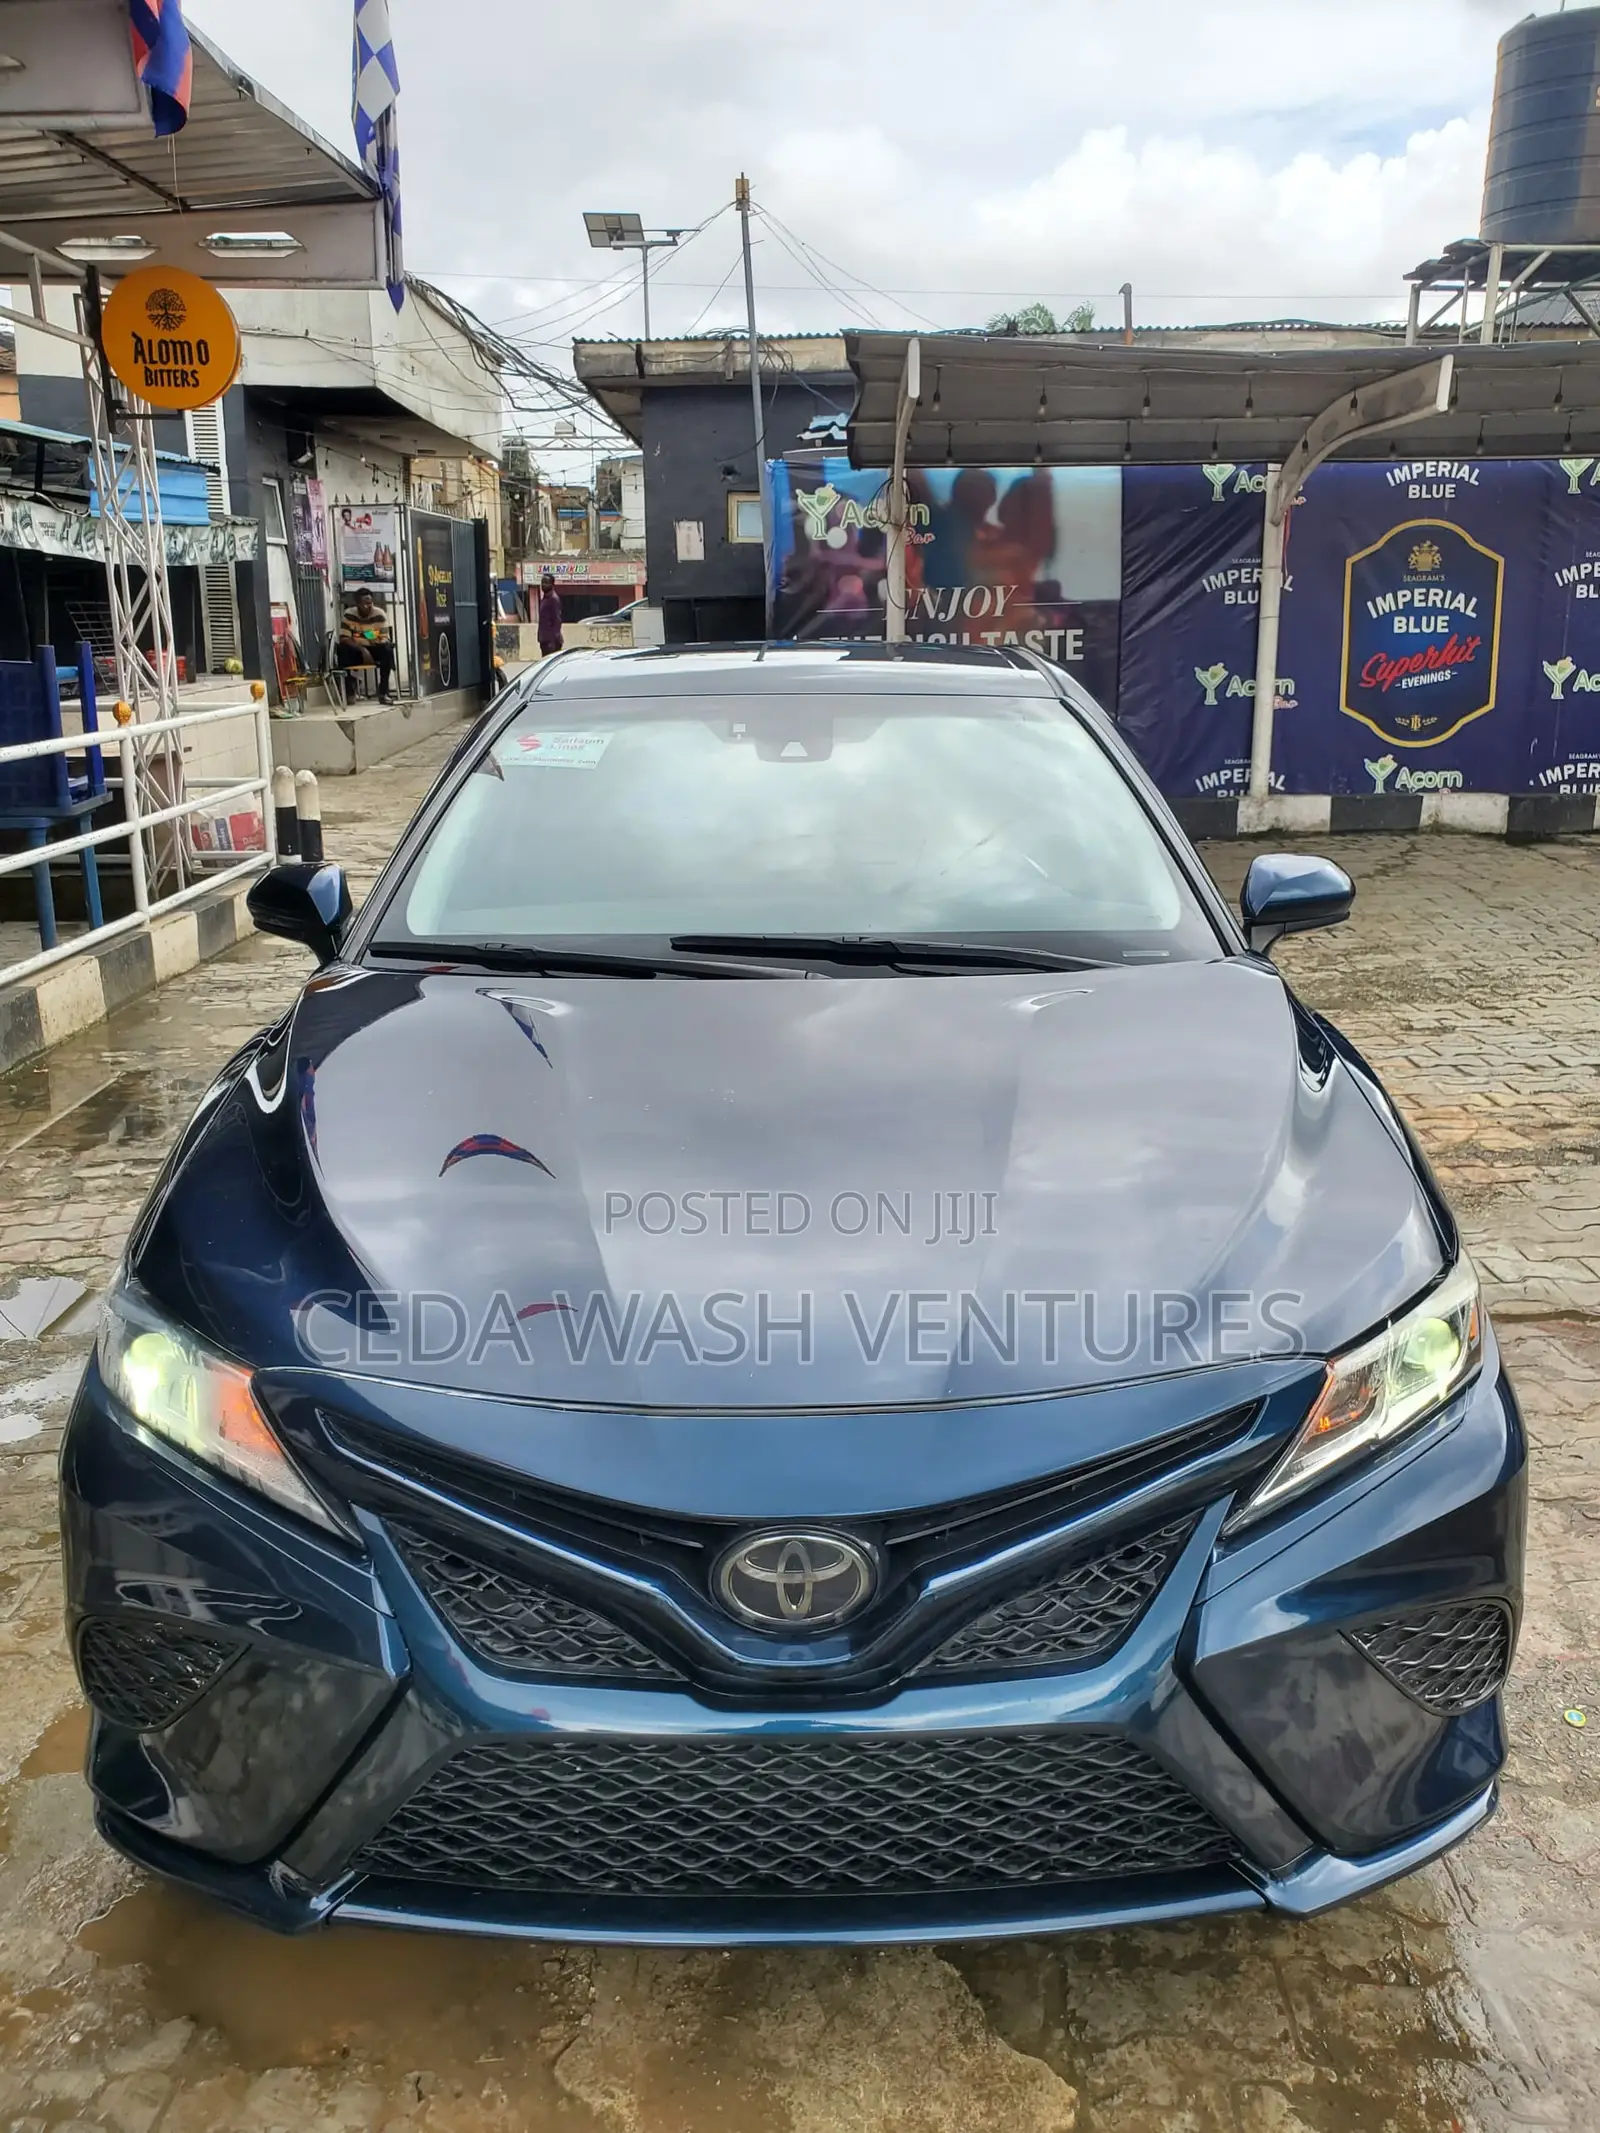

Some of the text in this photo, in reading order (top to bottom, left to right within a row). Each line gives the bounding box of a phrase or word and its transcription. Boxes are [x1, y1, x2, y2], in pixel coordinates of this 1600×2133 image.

[144, 366, 200, 388] BITTERS
[1386, 460, 1480, 487] IMPERIAL
[1408, 484, 1456, 499] BLUE
[840, 499, 930, 529] Acn
[568, 565, 588, 573] KIDS
[1202, 567, 1294, 593] IMPERL
[1402, 574, 1446, 583] SEAGRAM'S
[1224, 590, 1260, 605] BLU
[1576, 584, 1600, 599] BL
[1366, 587, 1478, 619] IMPERIAL
[1393, 615, 1450, 634] BLUE
[1359, 632, 1481, 693] Superhit
[1225, 674, 1296, 698] Acn
[1401, 669, 1452, 690] EVENINGS
[1394, 766, 1463, 790] Acorn
